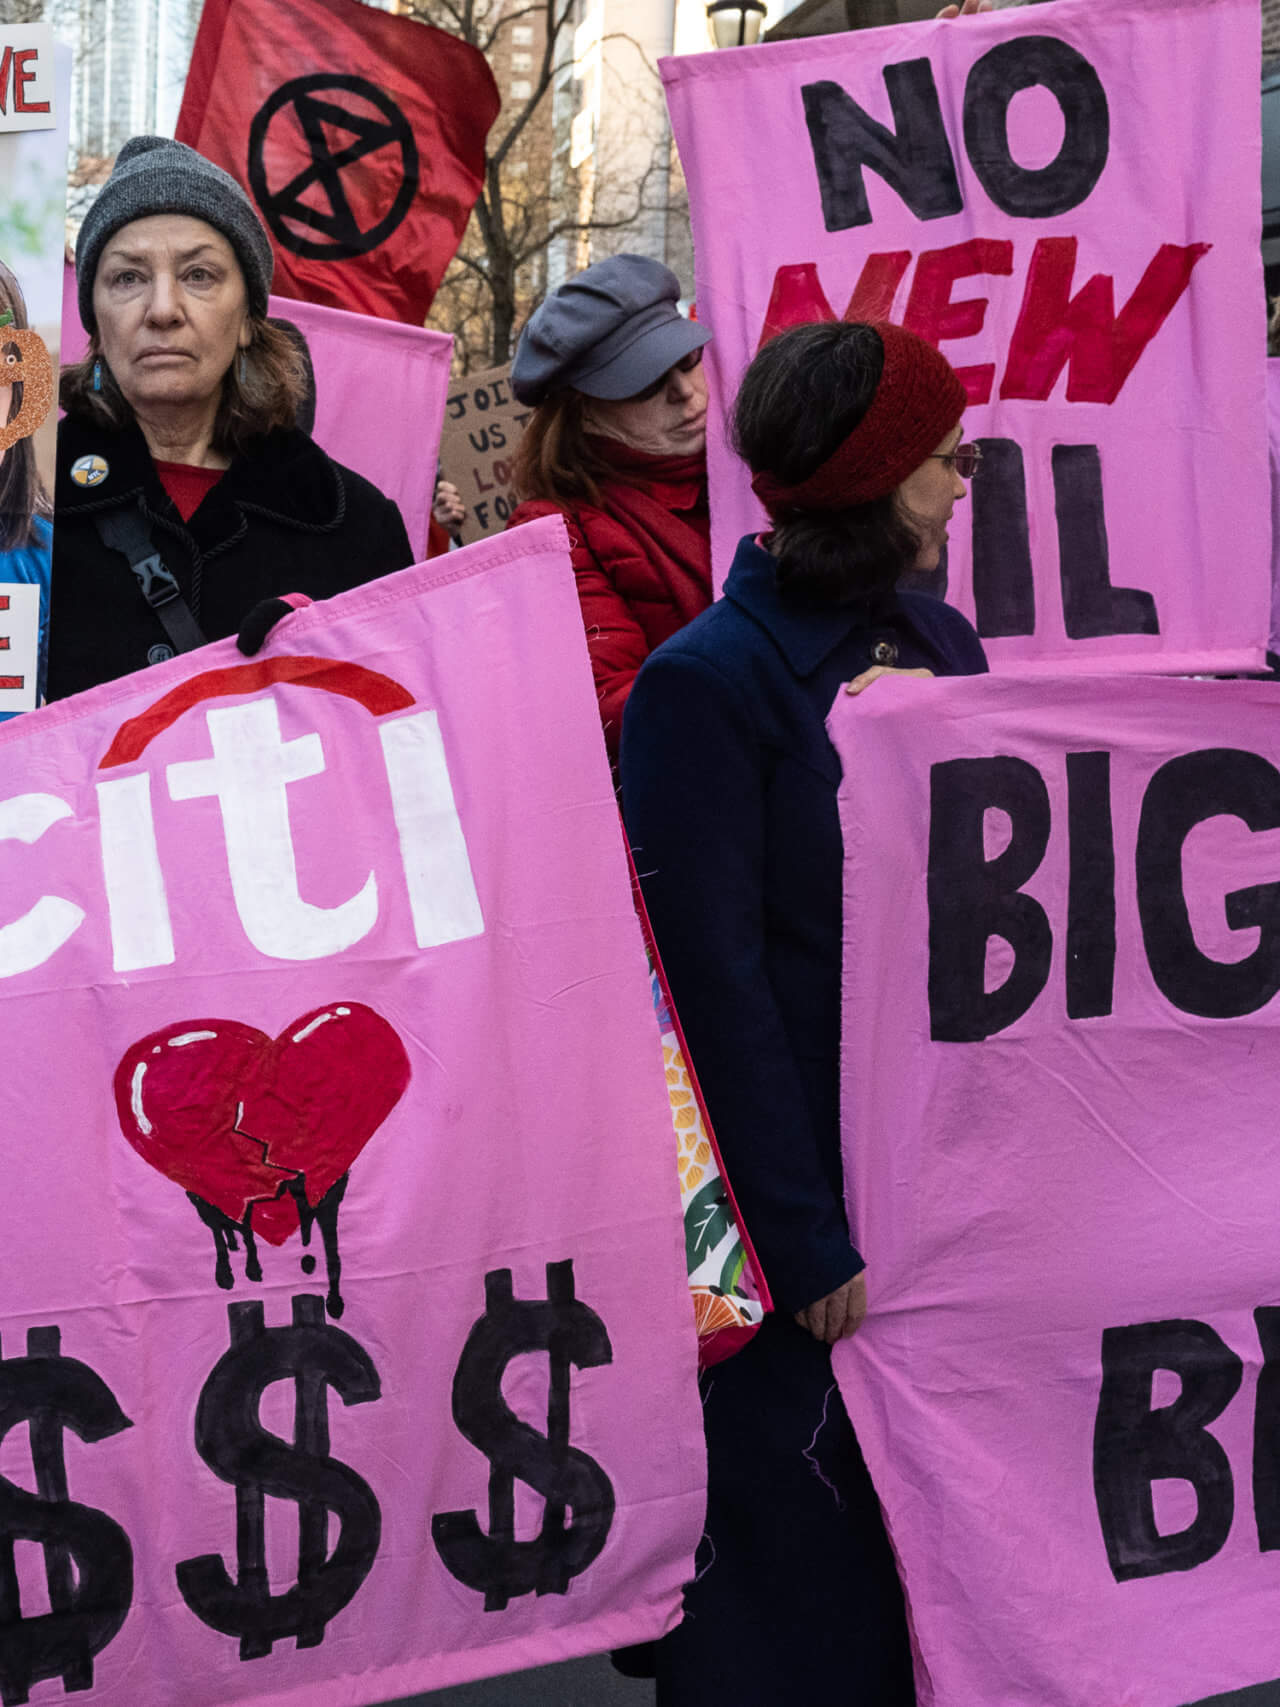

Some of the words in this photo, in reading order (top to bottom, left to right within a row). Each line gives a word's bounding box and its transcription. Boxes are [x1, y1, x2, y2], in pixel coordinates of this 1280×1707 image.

[800, 35, 1109, 232] NO
[446, 377, 514, 419] JOI
[469, 423, 507, 453] US
[895, 437, 1160, 640] IL
[927, 747, 1280, 1043] BIG
